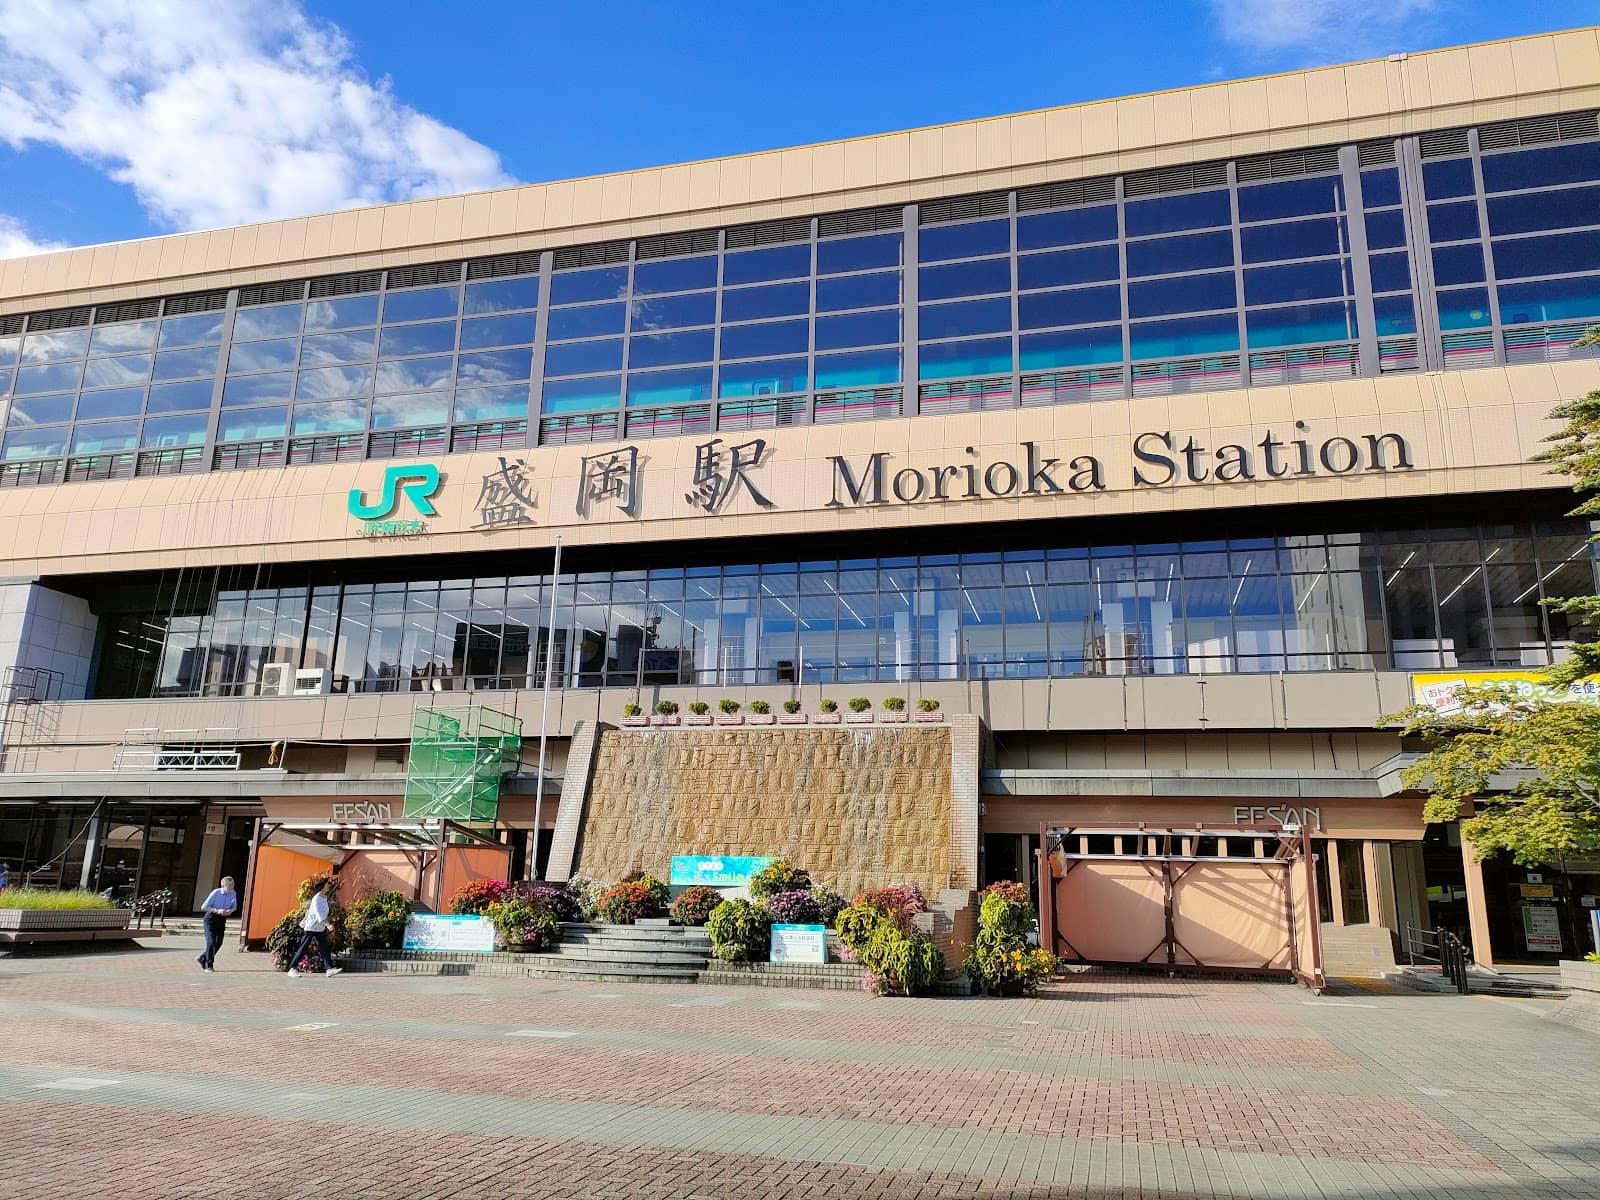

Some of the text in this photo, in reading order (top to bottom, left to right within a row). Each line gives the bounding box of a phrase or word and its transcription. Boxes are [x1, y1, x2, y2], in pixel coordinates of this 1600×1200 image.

[348, 464, 440, 519] JR
[471, 420, 1414, 529] 盛岡駅 Morioka Station
